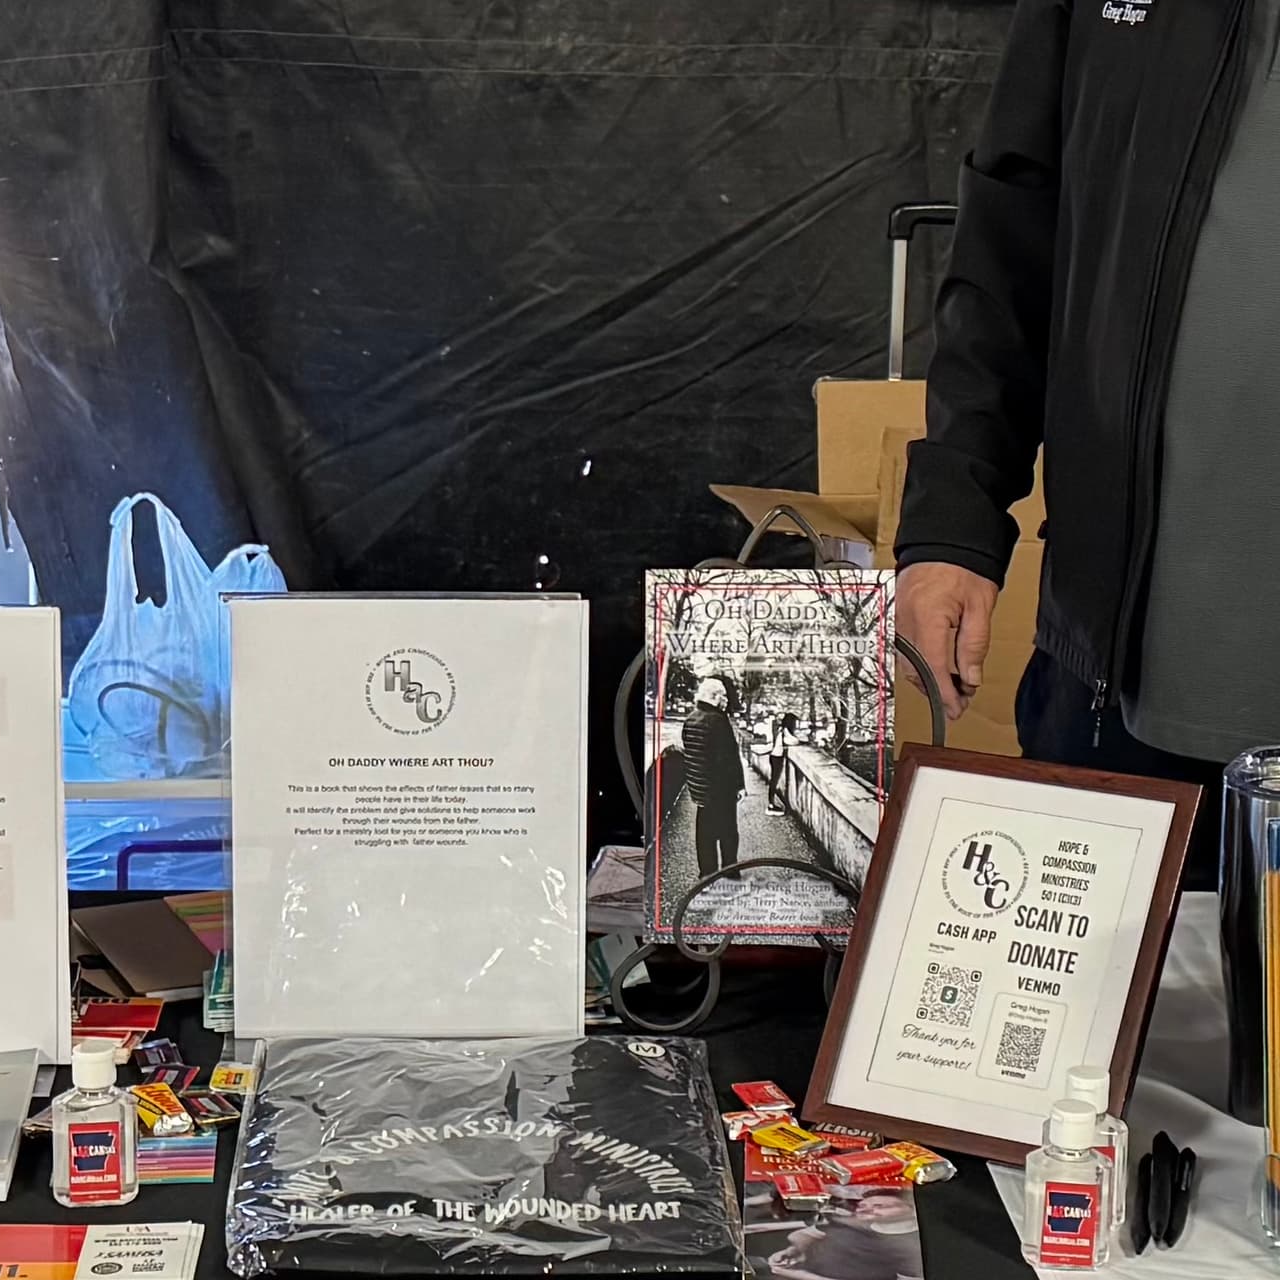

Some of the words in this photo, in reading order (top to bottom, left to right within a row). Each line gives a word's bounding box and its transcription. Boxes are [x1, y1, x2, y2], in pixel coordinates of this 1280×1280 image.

[327, 757, 345, 768] OH
[346, 757, 386, 768] DADDY
[387, 756, 429, 768] WHERE
[430, 756, 455, 768] ART
[455, 756, 494, 768] THOU?
[1057, 839, 1082, 856] HOPE
[1042, 854, 1098, 876] COMPASSION
[937, 921, 970, 939] CASH
[972, 928, 997, 944] APP
[1014, 905, 1064, 934] SCAN
[1067, 913, 1090, 939] TO
[1007, 940, 1079, 975] DONATE
[1017, 976, 1062, 997] VENMO
[902, 1023, 938, 1043] Thank
[938, 1035, 959, 1048] you
[956, 1038, 977, 1050] for
[350, 1117, 563, 1157] COMPASSION
[386, 1199, 419, 1219] OF
[432, 1197, 477, 1222] THE
[483, 1195, 601, 1224] WOUNDED
[608, 1200, 683, 1223] HEART
